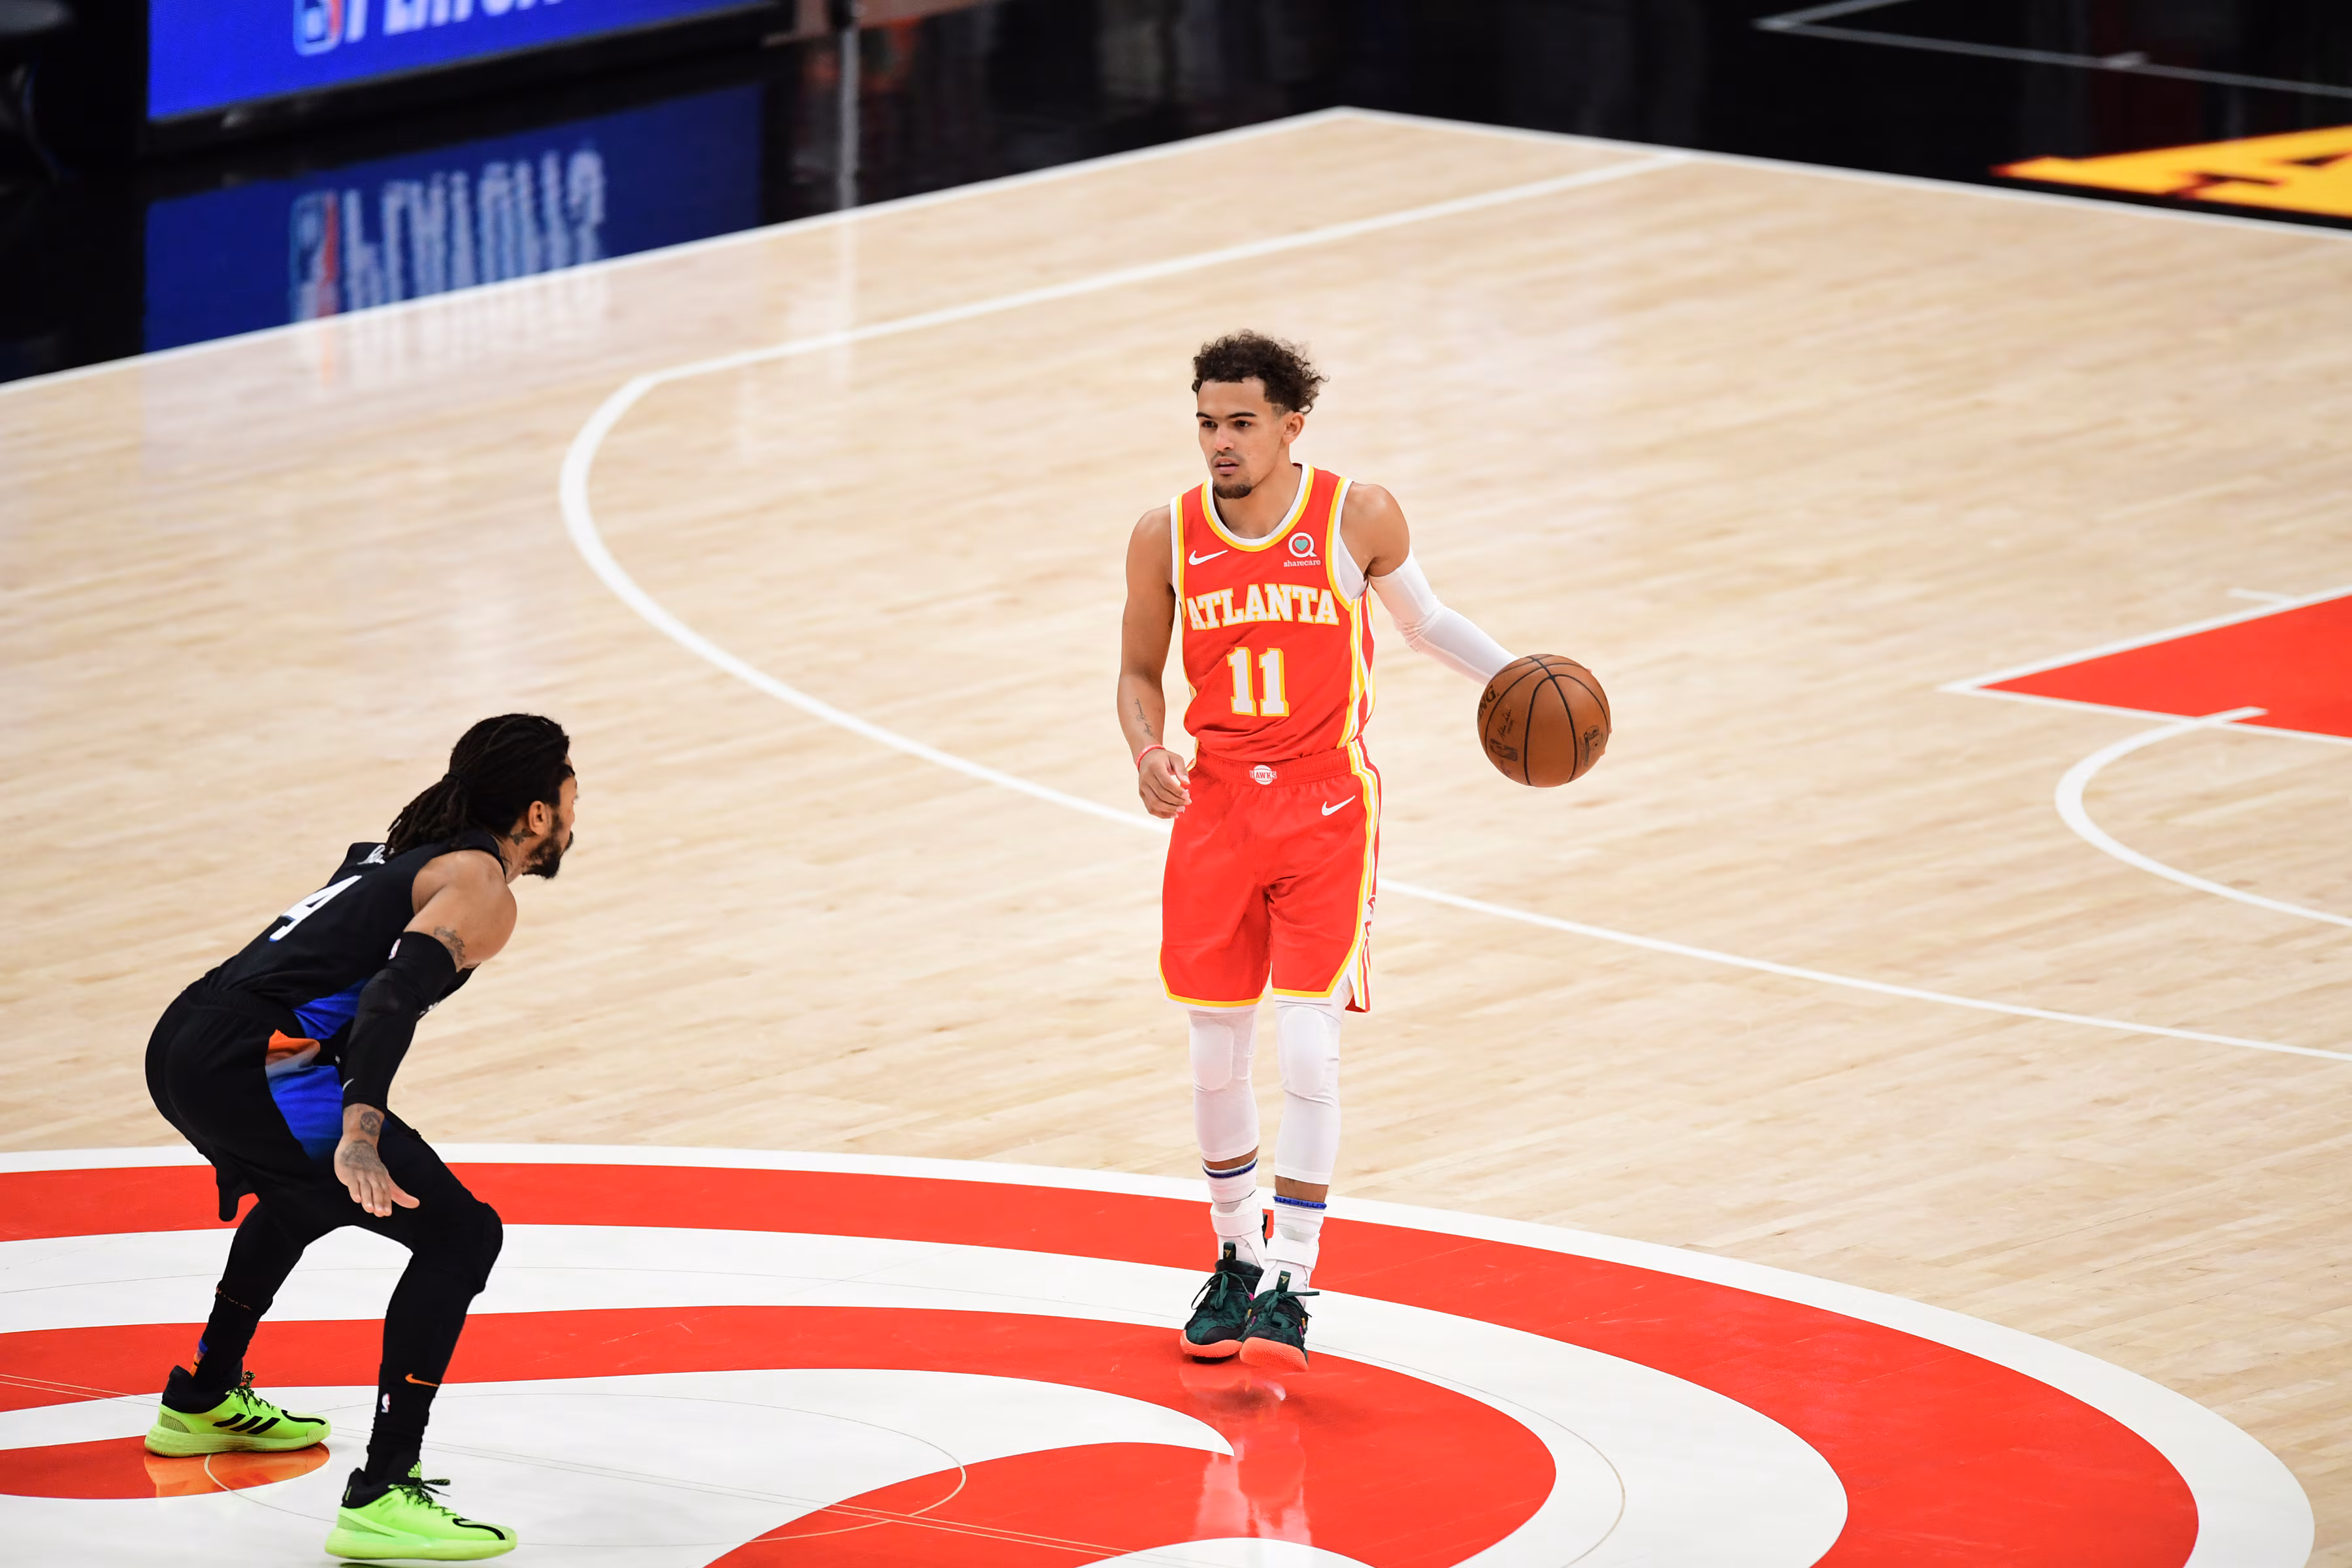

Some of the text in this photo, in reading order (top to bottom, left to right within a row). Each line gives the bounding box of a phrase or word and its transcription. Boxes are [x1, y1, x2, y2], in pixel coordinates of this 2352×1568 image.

[1186, 583, 1339, 631] ATLANTA
[1226, 646, 1290, 717] 11
[1249, 770, 1277, 779] HAWKS
[269, 874, 363, 942] 4
